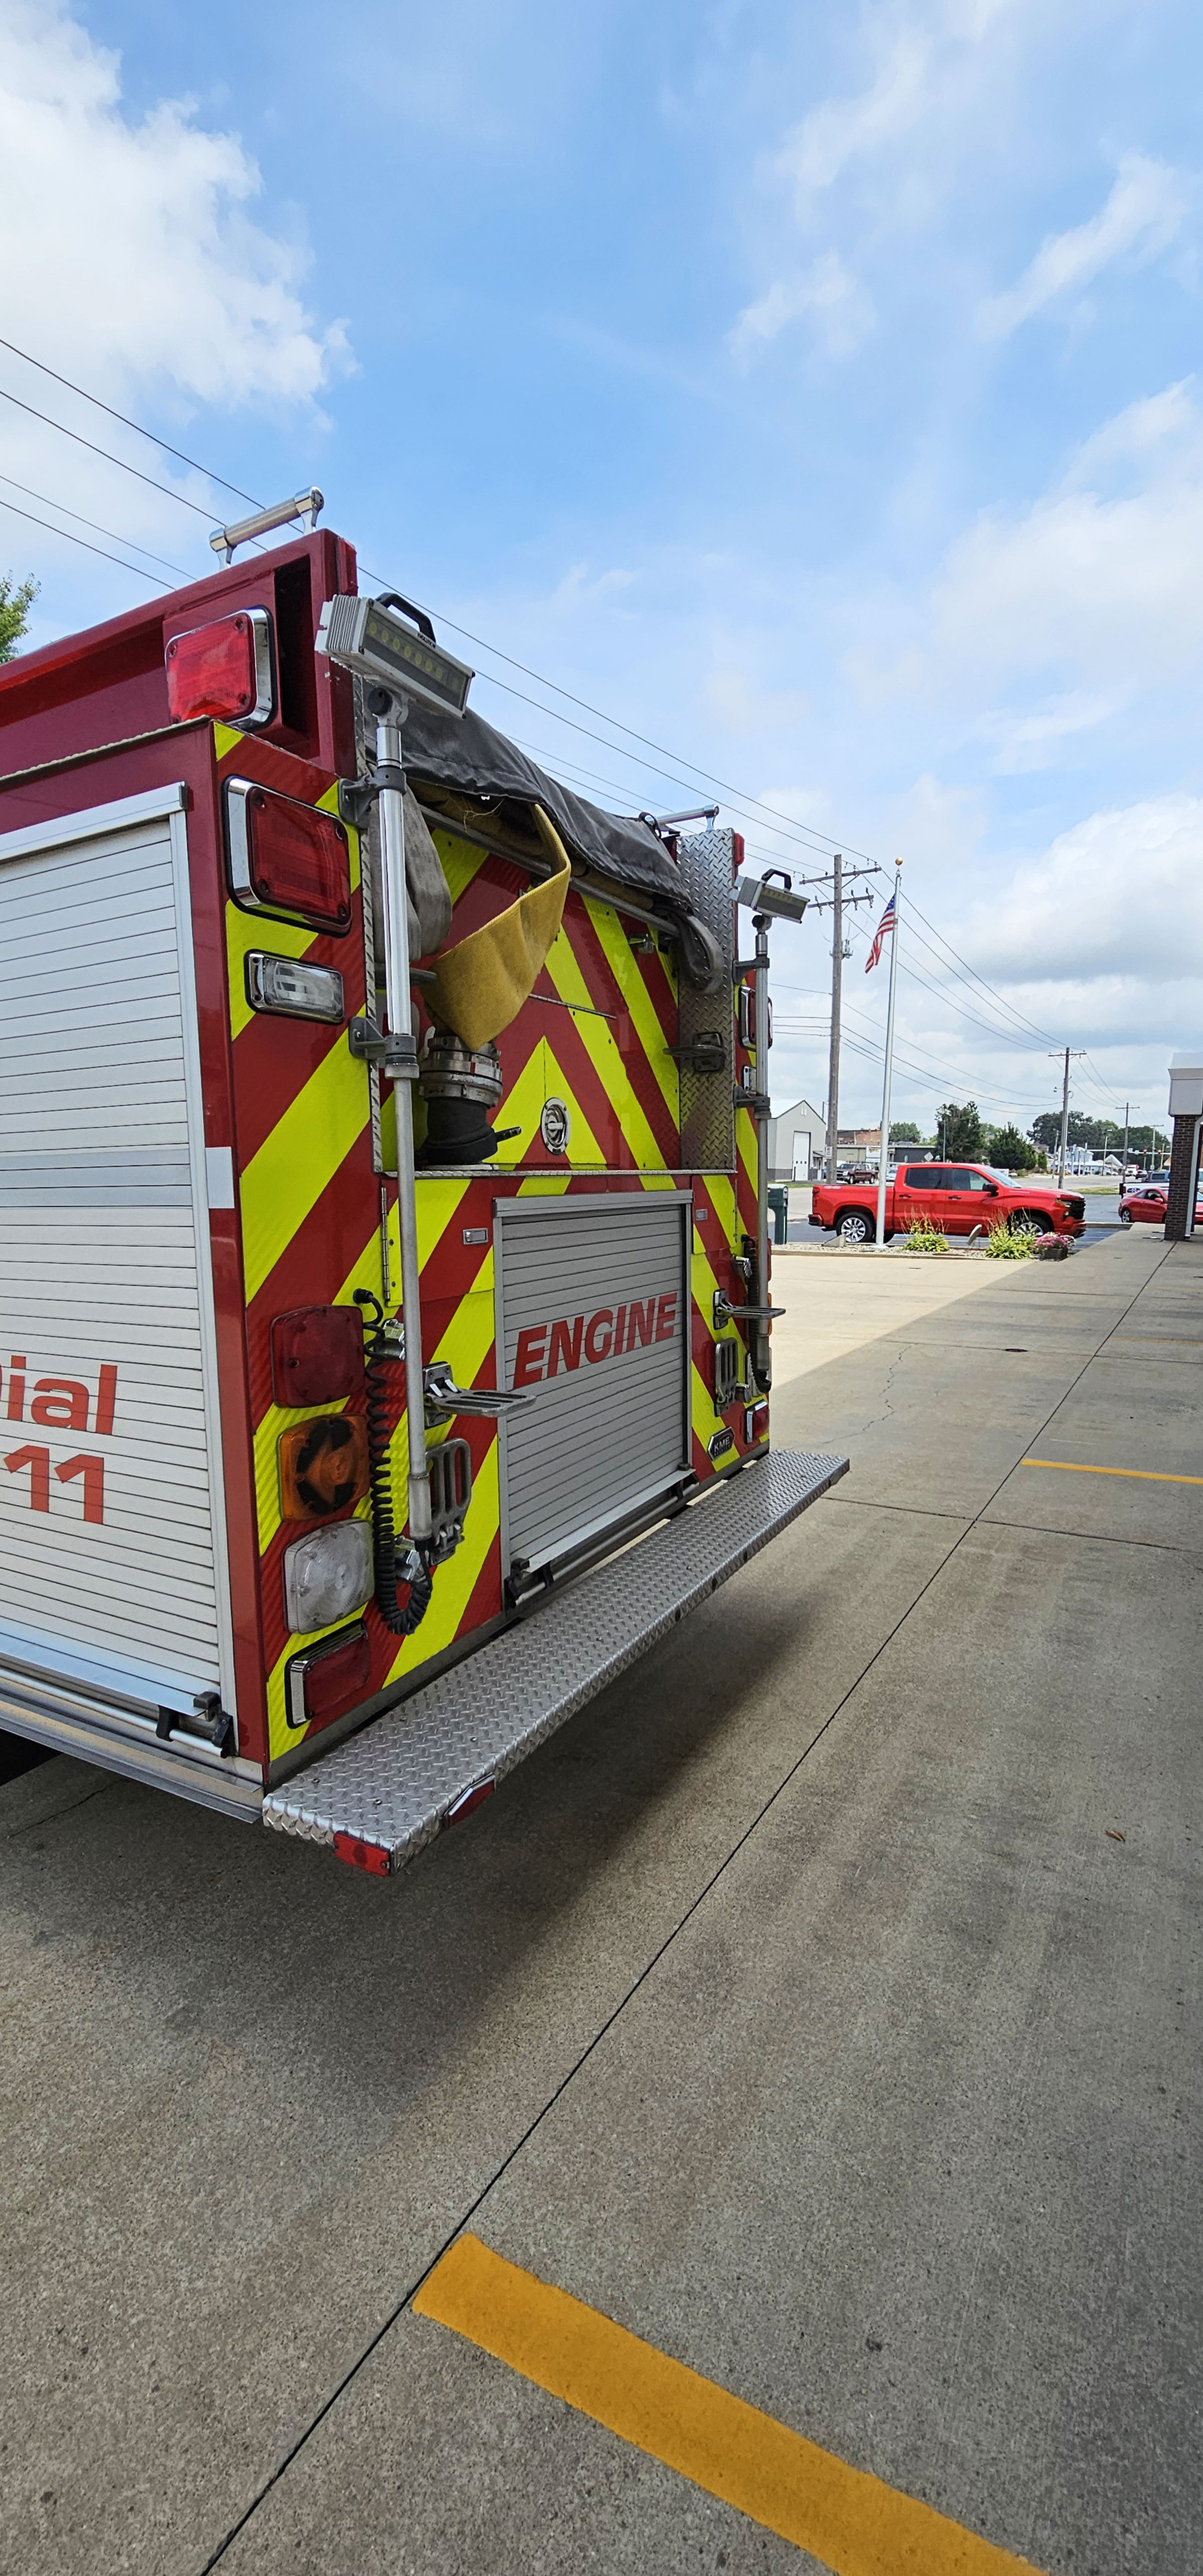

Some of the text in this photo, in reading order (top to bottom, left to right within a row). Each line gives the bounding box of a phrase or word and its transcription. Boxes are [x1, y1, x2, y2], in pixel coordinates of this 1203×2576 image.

[513, 1293, 678, 1390] ENGINE
[0, 1355, 118, 1435] ial
[714, 1436, 730, 1452] KME
[3, 1445, 104, 1525] 11
